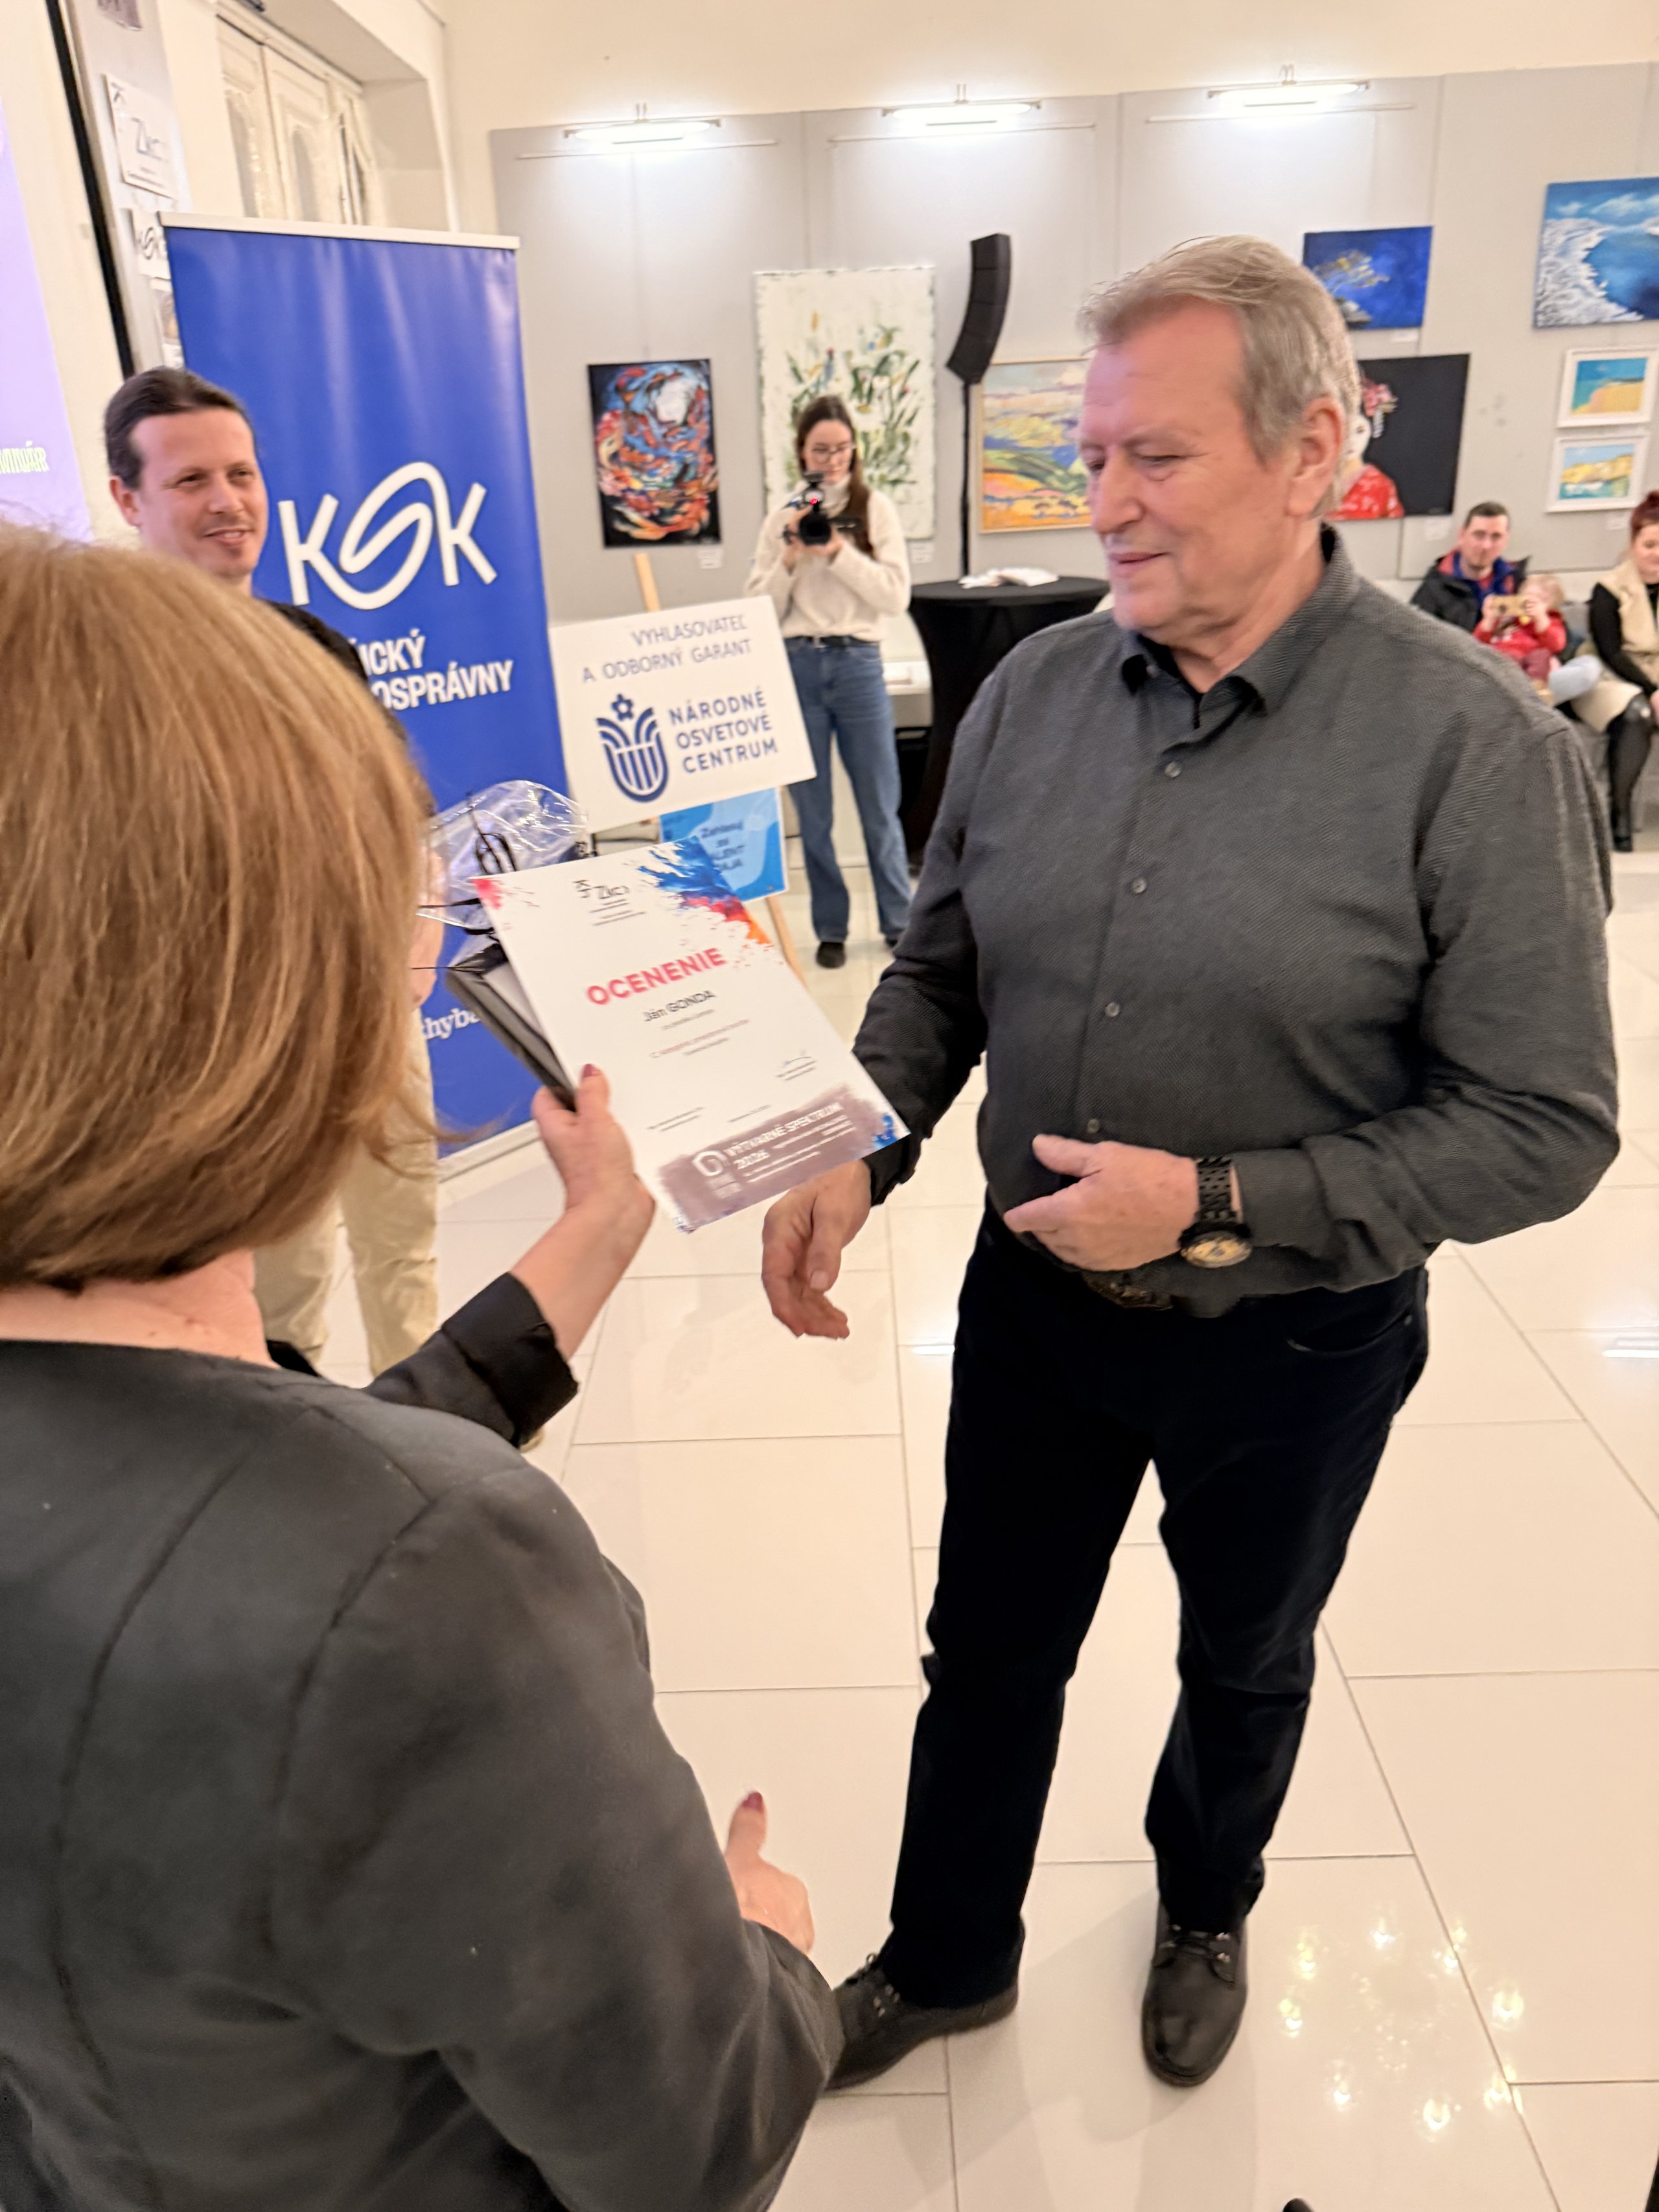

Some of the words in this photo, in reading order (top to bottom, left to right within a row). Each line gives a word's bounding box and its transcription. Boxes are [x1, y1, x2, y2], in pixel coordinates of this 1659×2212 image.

[278, 461, 497, 611] KSK
[351, 627, 426, 676] ICKÝ
[582, 667, 596, 682] A
[603, 648, 682, 679] ODBORNÝ
[691, 639, 750, 663] GARANT
[370, 661, 514, 710] OSPRÁVNY
[669, 686, 766, 726] NÁRODNÉ
[676, 710, 772, 749] OSVETOVÉ
[682, 738, 778, 773] CENTRUM
[585, 948, 727, 1005] OCENENIE
[666, 990, 716, 1012] GONDA
